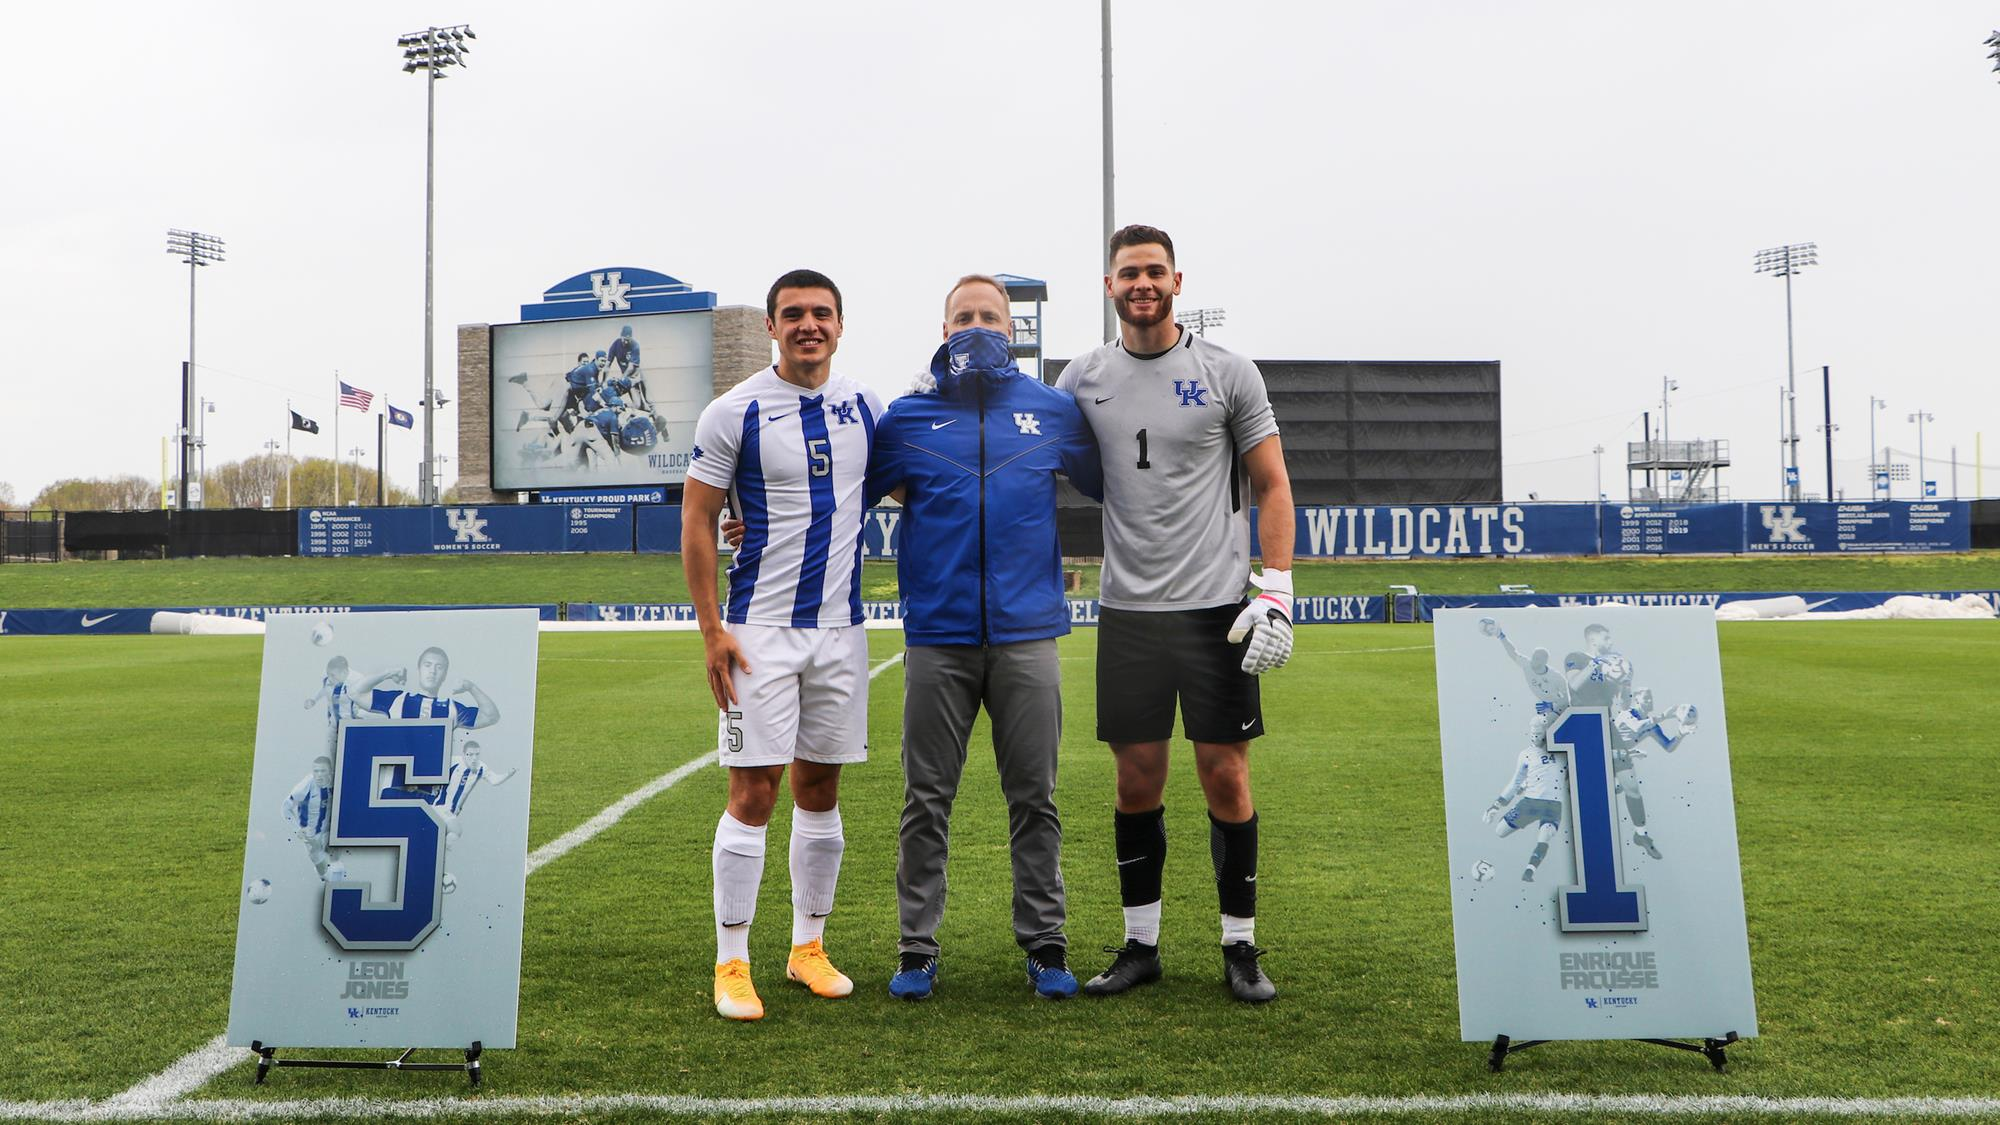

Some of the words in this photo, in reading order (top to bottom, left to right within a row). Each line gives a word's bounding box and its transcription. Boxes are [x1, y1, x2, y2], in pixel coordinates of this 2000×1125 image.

[591, 272, 631, 311] UK
[1172, 379, 1209, 407] UK
[1012, 412, 1042, 436] UK
[648, 453, 690, 468] WILDCA
[807, 438, 831, 477] 5
[1136, 428, 1151, 469] 1
[597, 495, 626, 503] PROUD
[628, 494, 650, 502] PARK
[446, 508, 488, 542] UK
[1305, 506, 1525, 555] WILDCATS
[1760, 506, 1807, 542] UK
[634, 605, 693, 621] KENT
[1296, 597, 1370, 620] TUCKY
[727, 711, 743, 752] 5
[1546, 705, 1649, 932] 1
[321, 717, 454, 950] 5
[349, 961, 404, 980] LEON
[1560, 951, 1657, 972] ENRIQUE
[340, 981, 409, 999] JONES
[1560, 971, 1659, 990] FACUSSE
[365, 1007, 400, 1015] KENTUCKY
[1603, 997, 1638, 1005] KENTUCKY
